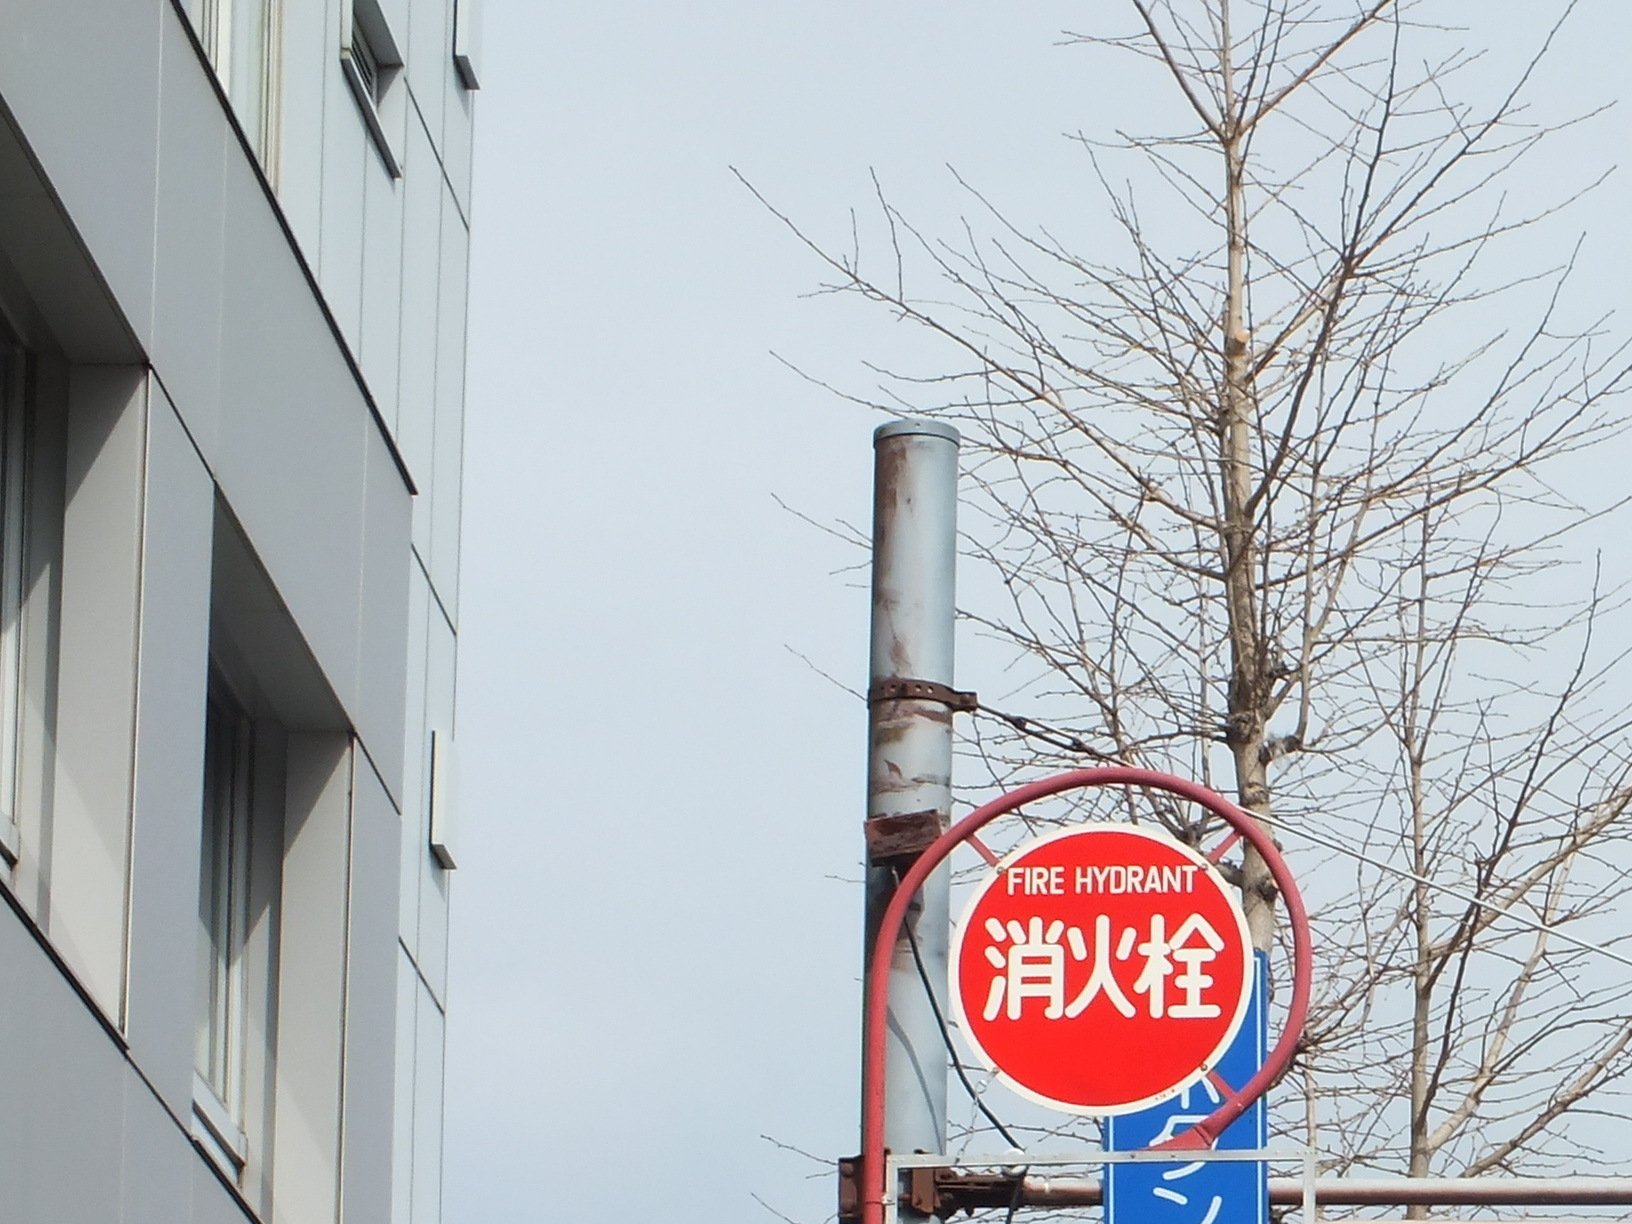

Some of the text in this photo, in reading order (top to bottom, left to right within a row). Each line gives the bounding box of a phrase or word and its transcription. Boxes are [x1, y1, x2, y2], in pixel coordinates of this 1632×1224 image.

[1007, 865, 1199, 896] FIRE HYDRANT
[982, 912, 1226, 1022] 消火栓
